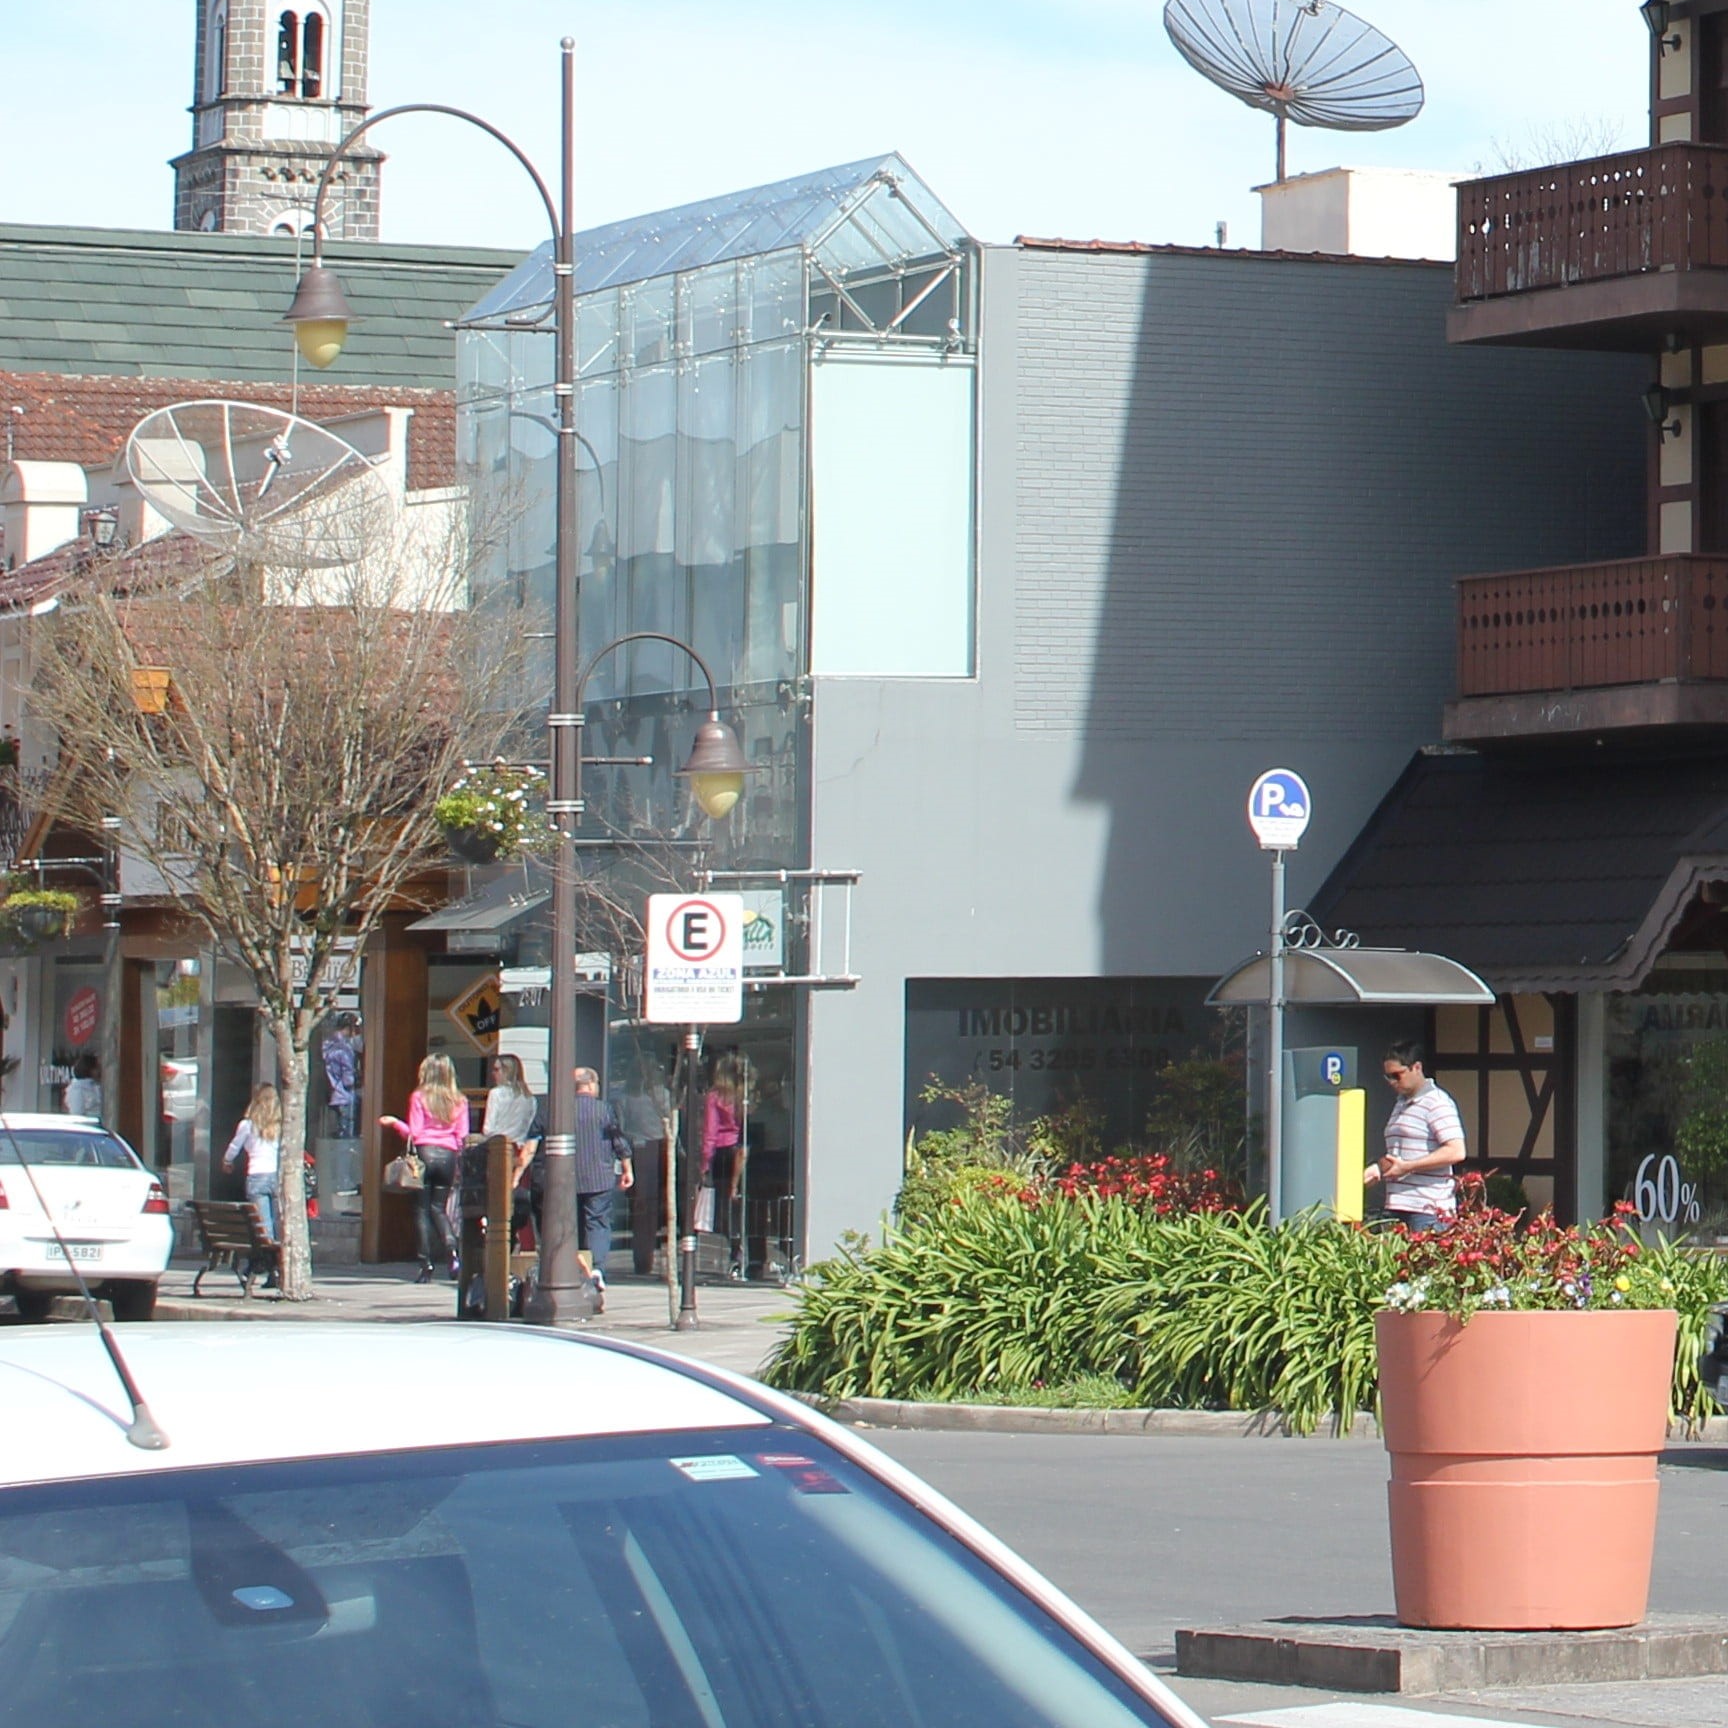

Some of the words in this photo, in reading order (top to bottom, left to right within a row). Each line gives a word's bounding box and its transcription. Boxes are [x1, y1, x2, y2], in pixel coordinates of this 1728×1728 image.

[683, 912, 709, 951] E
[700, 968, 734, 980] AZUL
[477, 1014, 497, 1031] OFF
[988, 1049, 1021, 1071] 54
[1634, 1153, 1700, 1224] 60%
